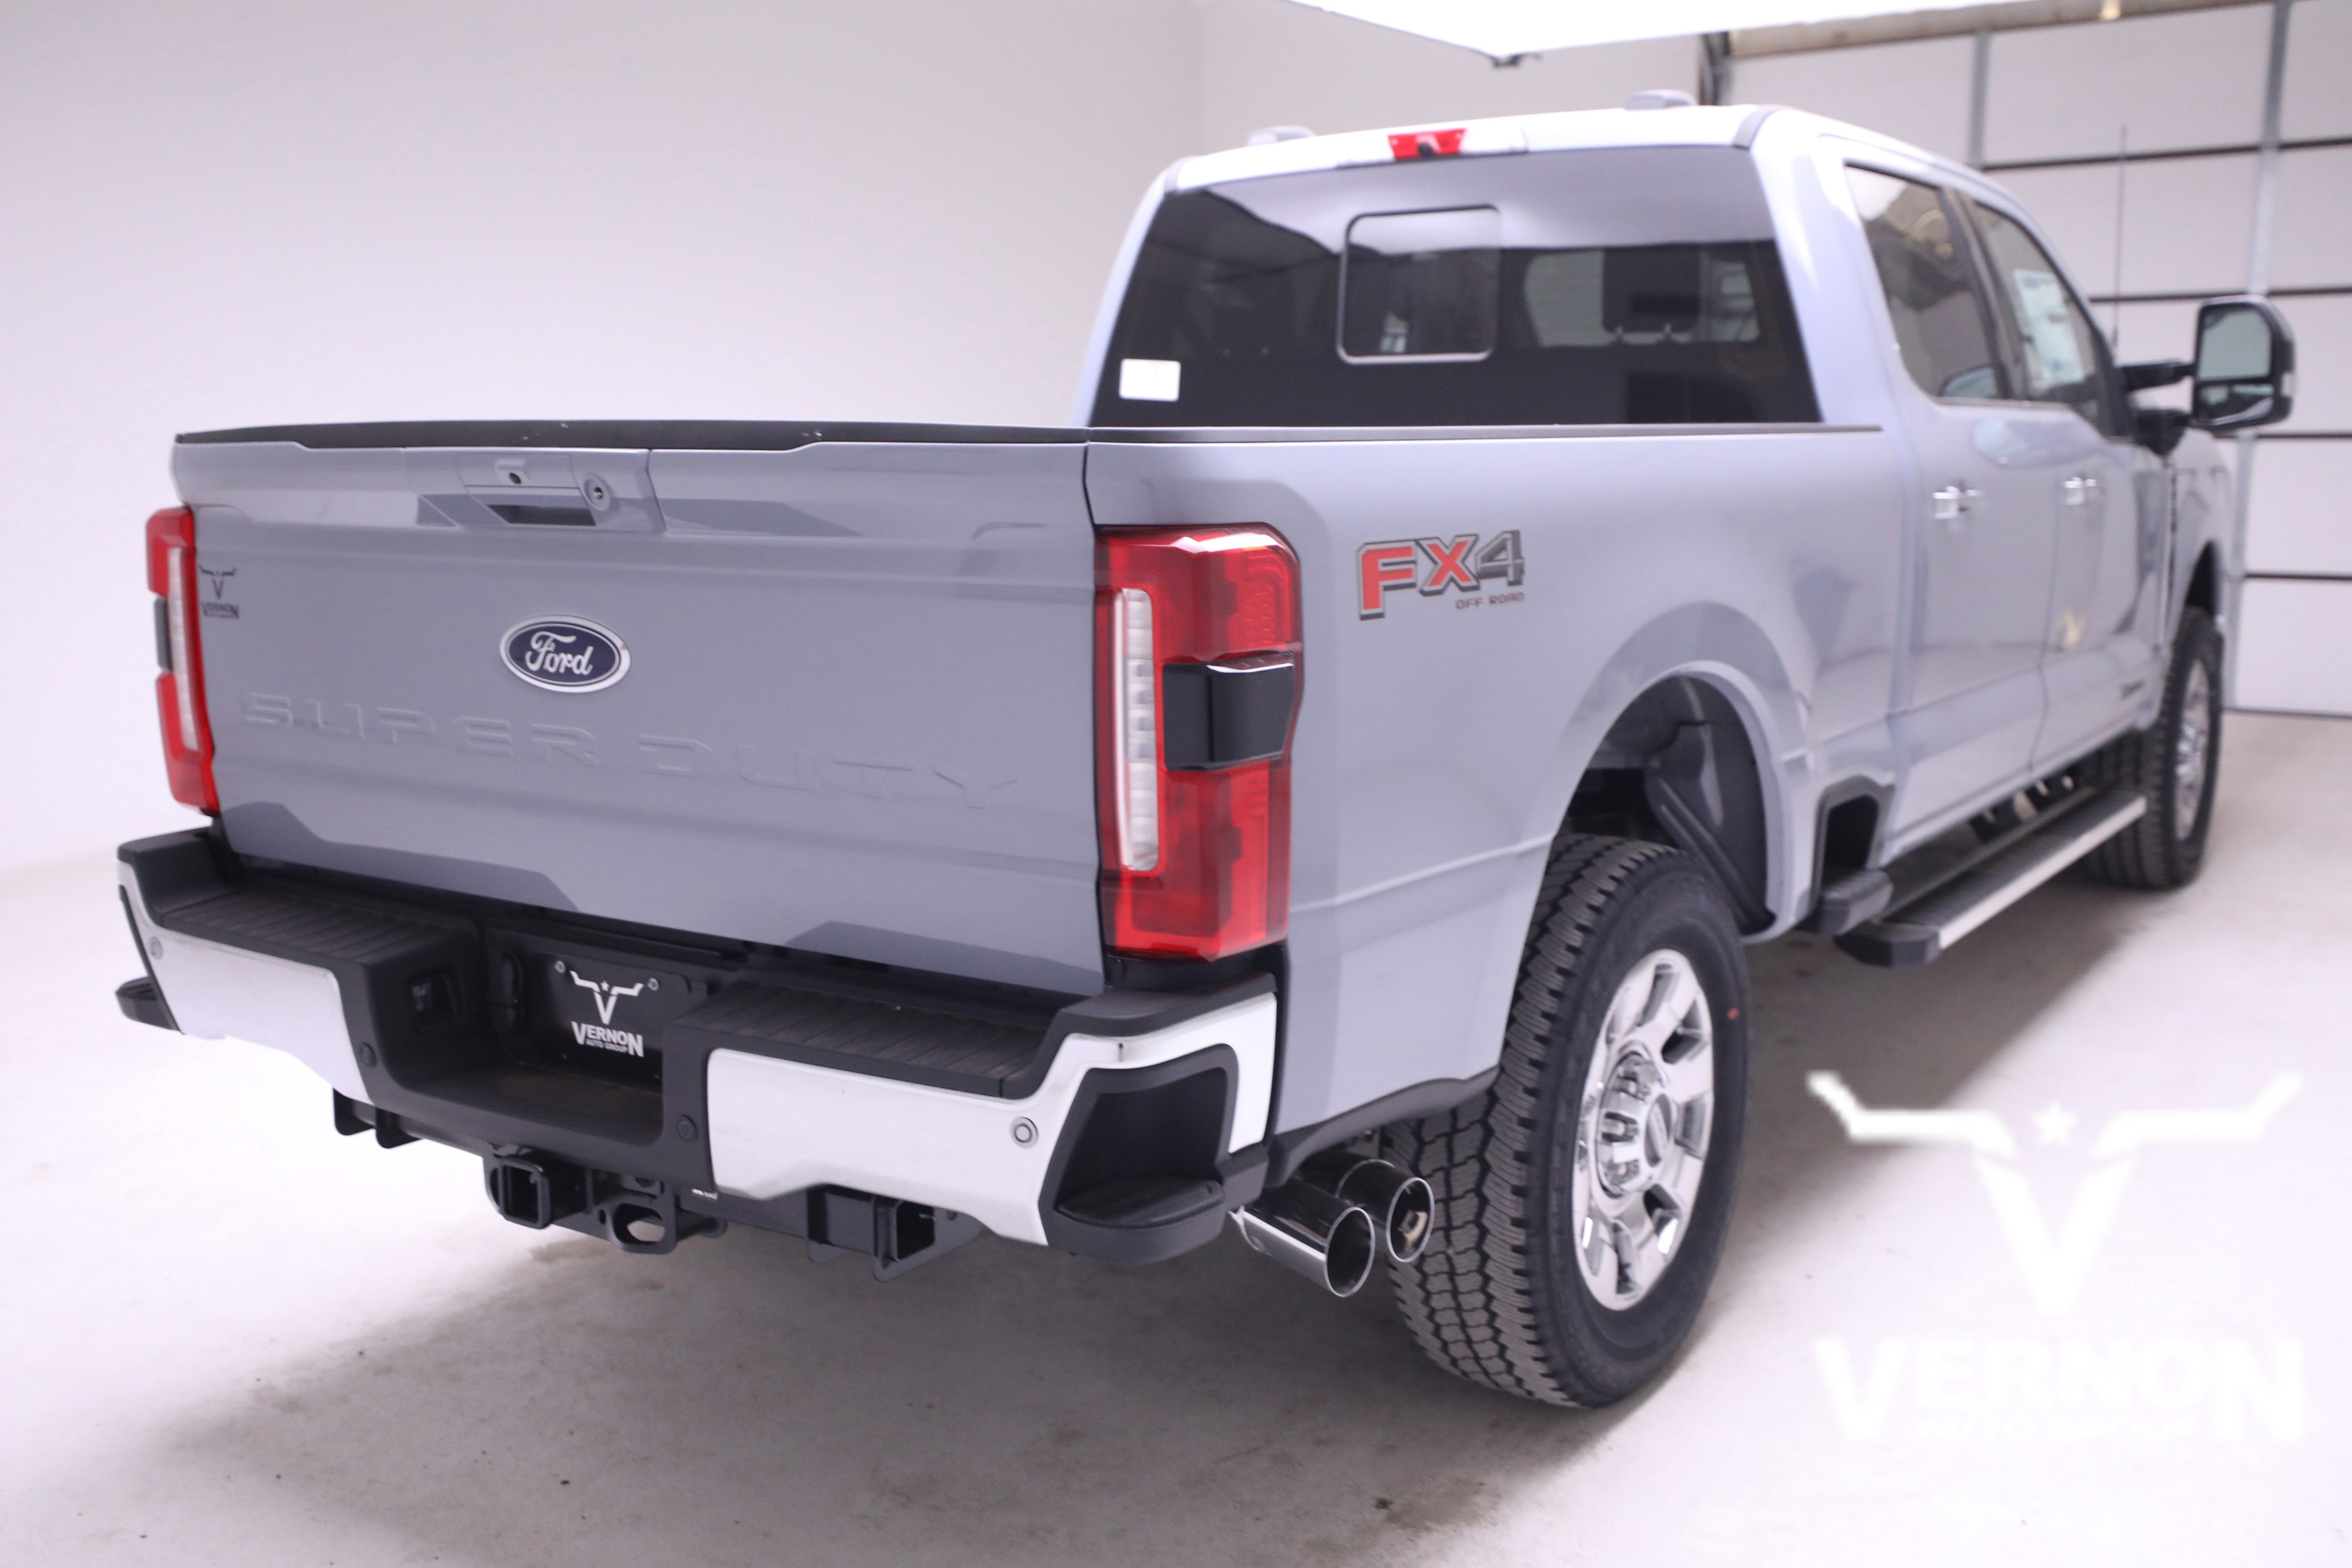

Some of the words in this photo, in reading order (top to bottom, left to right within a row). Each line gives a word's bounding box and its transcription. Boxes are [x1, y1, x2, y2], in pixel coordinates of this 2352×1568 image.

[1356, 529, 1525, 621] FX4
[1455, 597, 1484, 609] OFF
[1489, 592, 1525, 605] ROAD
[525, 631, 594, 675] Ford
[240, 692, 599, 768] SUPER
[637, 734, 1020, 811] DUTY
[571, 1021, 644, 1058] VERNON
